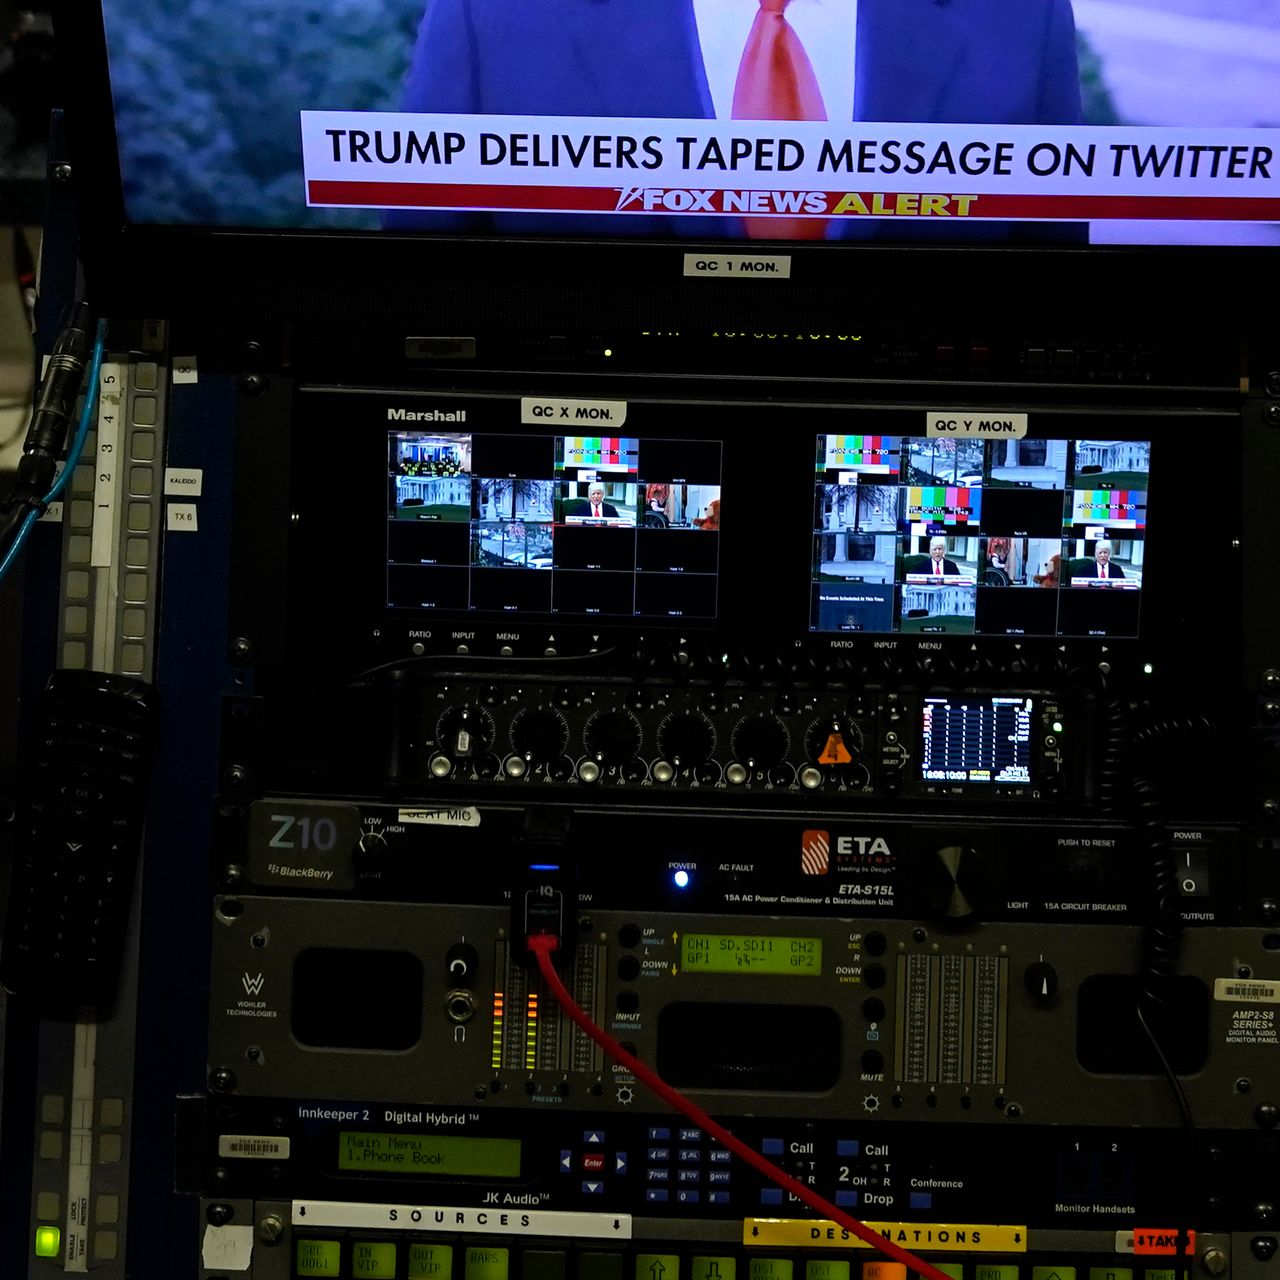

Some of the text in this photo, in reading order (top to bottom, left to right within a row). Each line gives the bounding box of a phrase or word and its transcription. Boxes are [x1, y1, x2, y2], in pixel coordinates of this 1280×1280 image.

[326, 129, 1274, 179] TRUMP DELIVERS TAPED MESSAGE ON TWITTER
[644, 188, 979, 217] FOX NEWS ALERT
[695, 260, 780, 274] QC 1 MON.
[104, 375, 116, 384] 5
[387, 408, 467, 423] Marshall
[531, 406, 613, 421] QC X MON.
[104, 415, 114, 424] 4
[935, 420, 1017, 434] QC Y MON.
[102, 443, 113, 453] 3
[100, 472, 111, 482] 2
[408, 630, 432, 639] RATIO
[452, 631, 476, 640] INPUT
[496, 632, 520, 641] MENU
[830, 640, 855, 649] RATIO
[874, 641, 898, 650] INPUT
[918, 642, 943, 650] MENU
[535, 764, 543, 774] 2
[608, 766, 616, 776] 3
[364, 817, 383, 826] LOW
[446, 811, 472, 822] MIC
[269, 815, 337, 850] Z10
[386, 826, 405, 834] HIGH
[1173, 832, 1202, 840] POWER
[837, 837, 892, 856] ETA
[1057, 839, 1080, 847] PUSH
[1094, 840, 1117, 848] RESET
[669, 862, 698, 870] POWER
[719, 864, 756, 872] AC FAULT
[280, 867, 334, 881] BlackBerry
[838, 883, 895, 896] ETA-S15L
[755, 895, 779, 904] Power
[781, 896, 823, 905] Conditioner
[832, 897, 877, 906] Distribution
[879, 899, 895, 907] Unit
[1007, 901, 1029, 910] LIGHT
[1044, 902, 1128, 912] 15A CIRCUIT BREAKER
[643, 928, 656, 937] UP
[849, 933, 862, 942] UP
[687, 939, 709, 952] CH1
[791, 941, 815, 953] CH2
[687, 952, 815, 967] GP1 GP2
[853, 954, 860, 962] R
[642, 960, 668, 969] DOWN
[835, 966, 862, 975] DOWN
[238, 1000, 267, 1010] WOHLER
[226, 1008, 278, 1019] TECHNOLOGIES
[615, 1012, 641, 1022] INPUT
[1232, 1010, 1275, 1020] AMP2-S8
[1232, 1020, 1274, 1029] SERIES+
[1228, 1029, 1277, 1038] DIGITAL AUDIO
[1226, 1036, 1280, 1045] MONITOR PANEL
[860, 1073, 885, 1082] MUTE
[532, 1096, 563, 1105] PRESETS
[298, 1107, 370, 1124] innkeeper 2
[384, 1111, 466, 1127] Digital Hybrid
[346, 1135, 422, 1151] Main Menu
[789, 1142, 814, 1154] Call
[1074, 1142, 1080, 1152] 1
[1111, 1142, 1118, 1152] 2
[865, 1144, 889, 1157] Call
[346, 1150, 445, 1166] 1.Phone Book
[584, 1157, 603, 1168] Enter
[809, 1162, 816, 1170] T
[884, 1164, 891, 1172] T
[839, 1166, 850, 1182] 2
[808, 1175, 816, 1185] R
[853, 1176, 868, 1187] OH
[884, 1177, 892, 1187] R
[910, 1178, 964, 1191] Conference
[482, 1193, 502, 1207] JK
[864, 1193, 894, 1209] Drop
[1055, 1202, 1136, 1214] Monitor Handsets
[1148, 1236, 1179, 1247] TAK
[359, 1248, 372, 1258] IN
[471, 1254, 499, 1264] BARS
